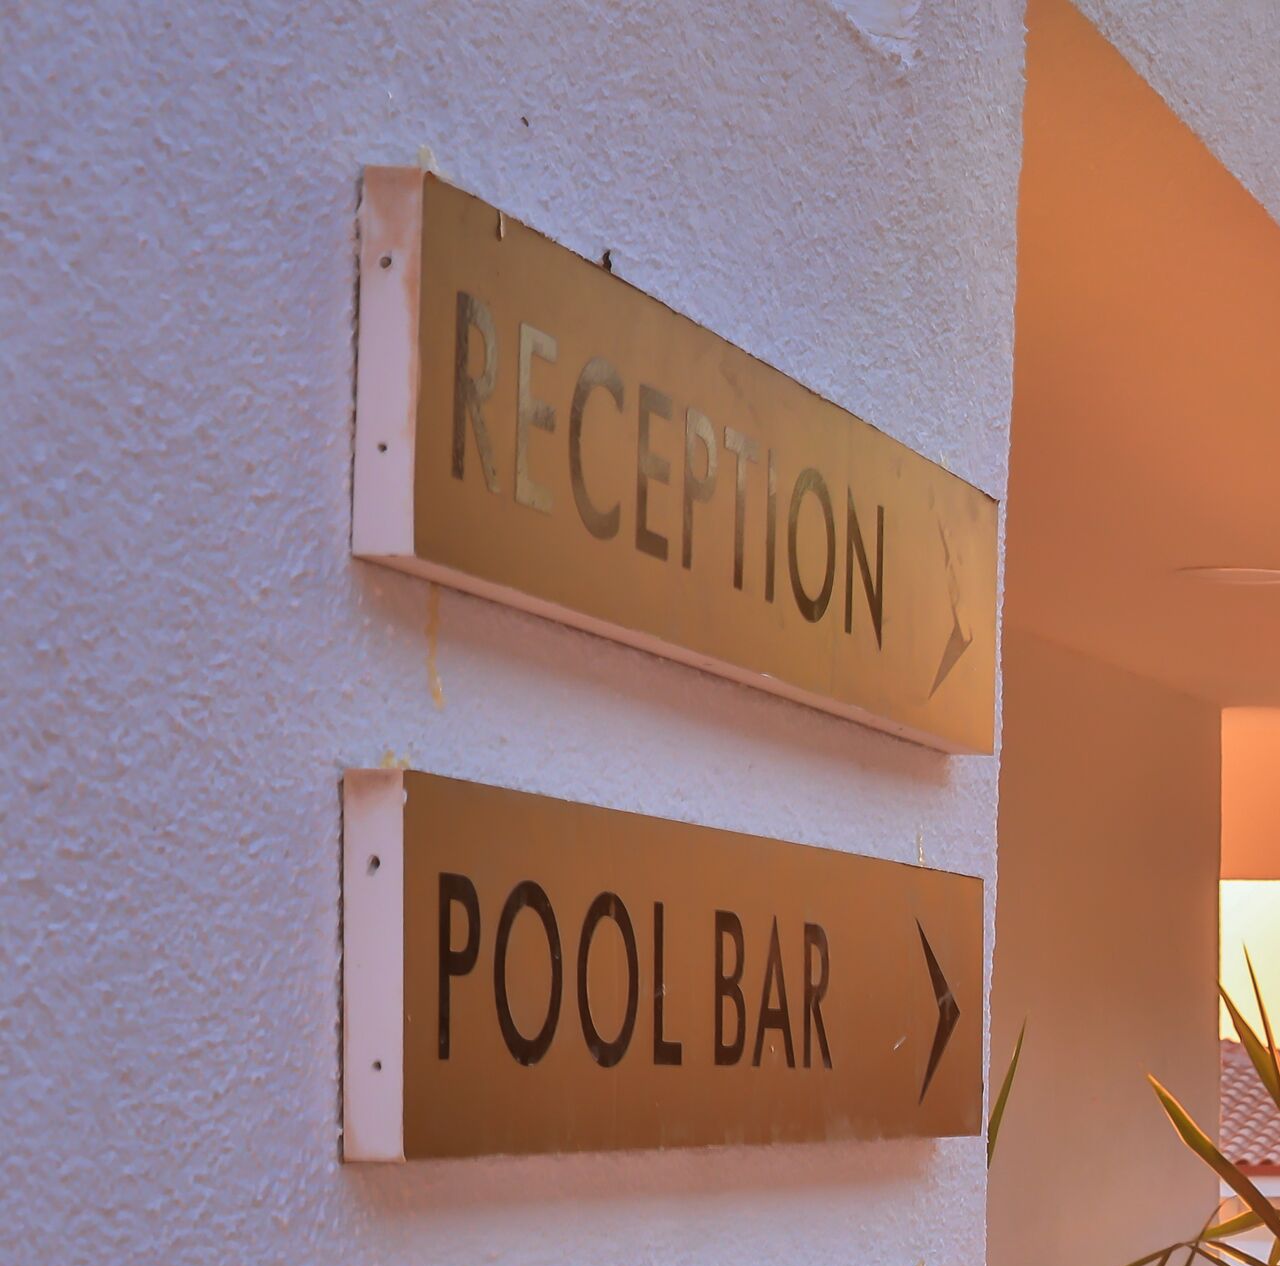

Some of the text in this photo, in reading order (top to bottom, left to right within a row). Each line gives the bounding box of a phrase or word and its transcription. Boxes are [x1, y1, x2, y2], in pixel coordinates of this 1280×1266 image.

[450, 290, 886, 651] RECEPTION
[437, 872, 834, 1069] POOL BAR
